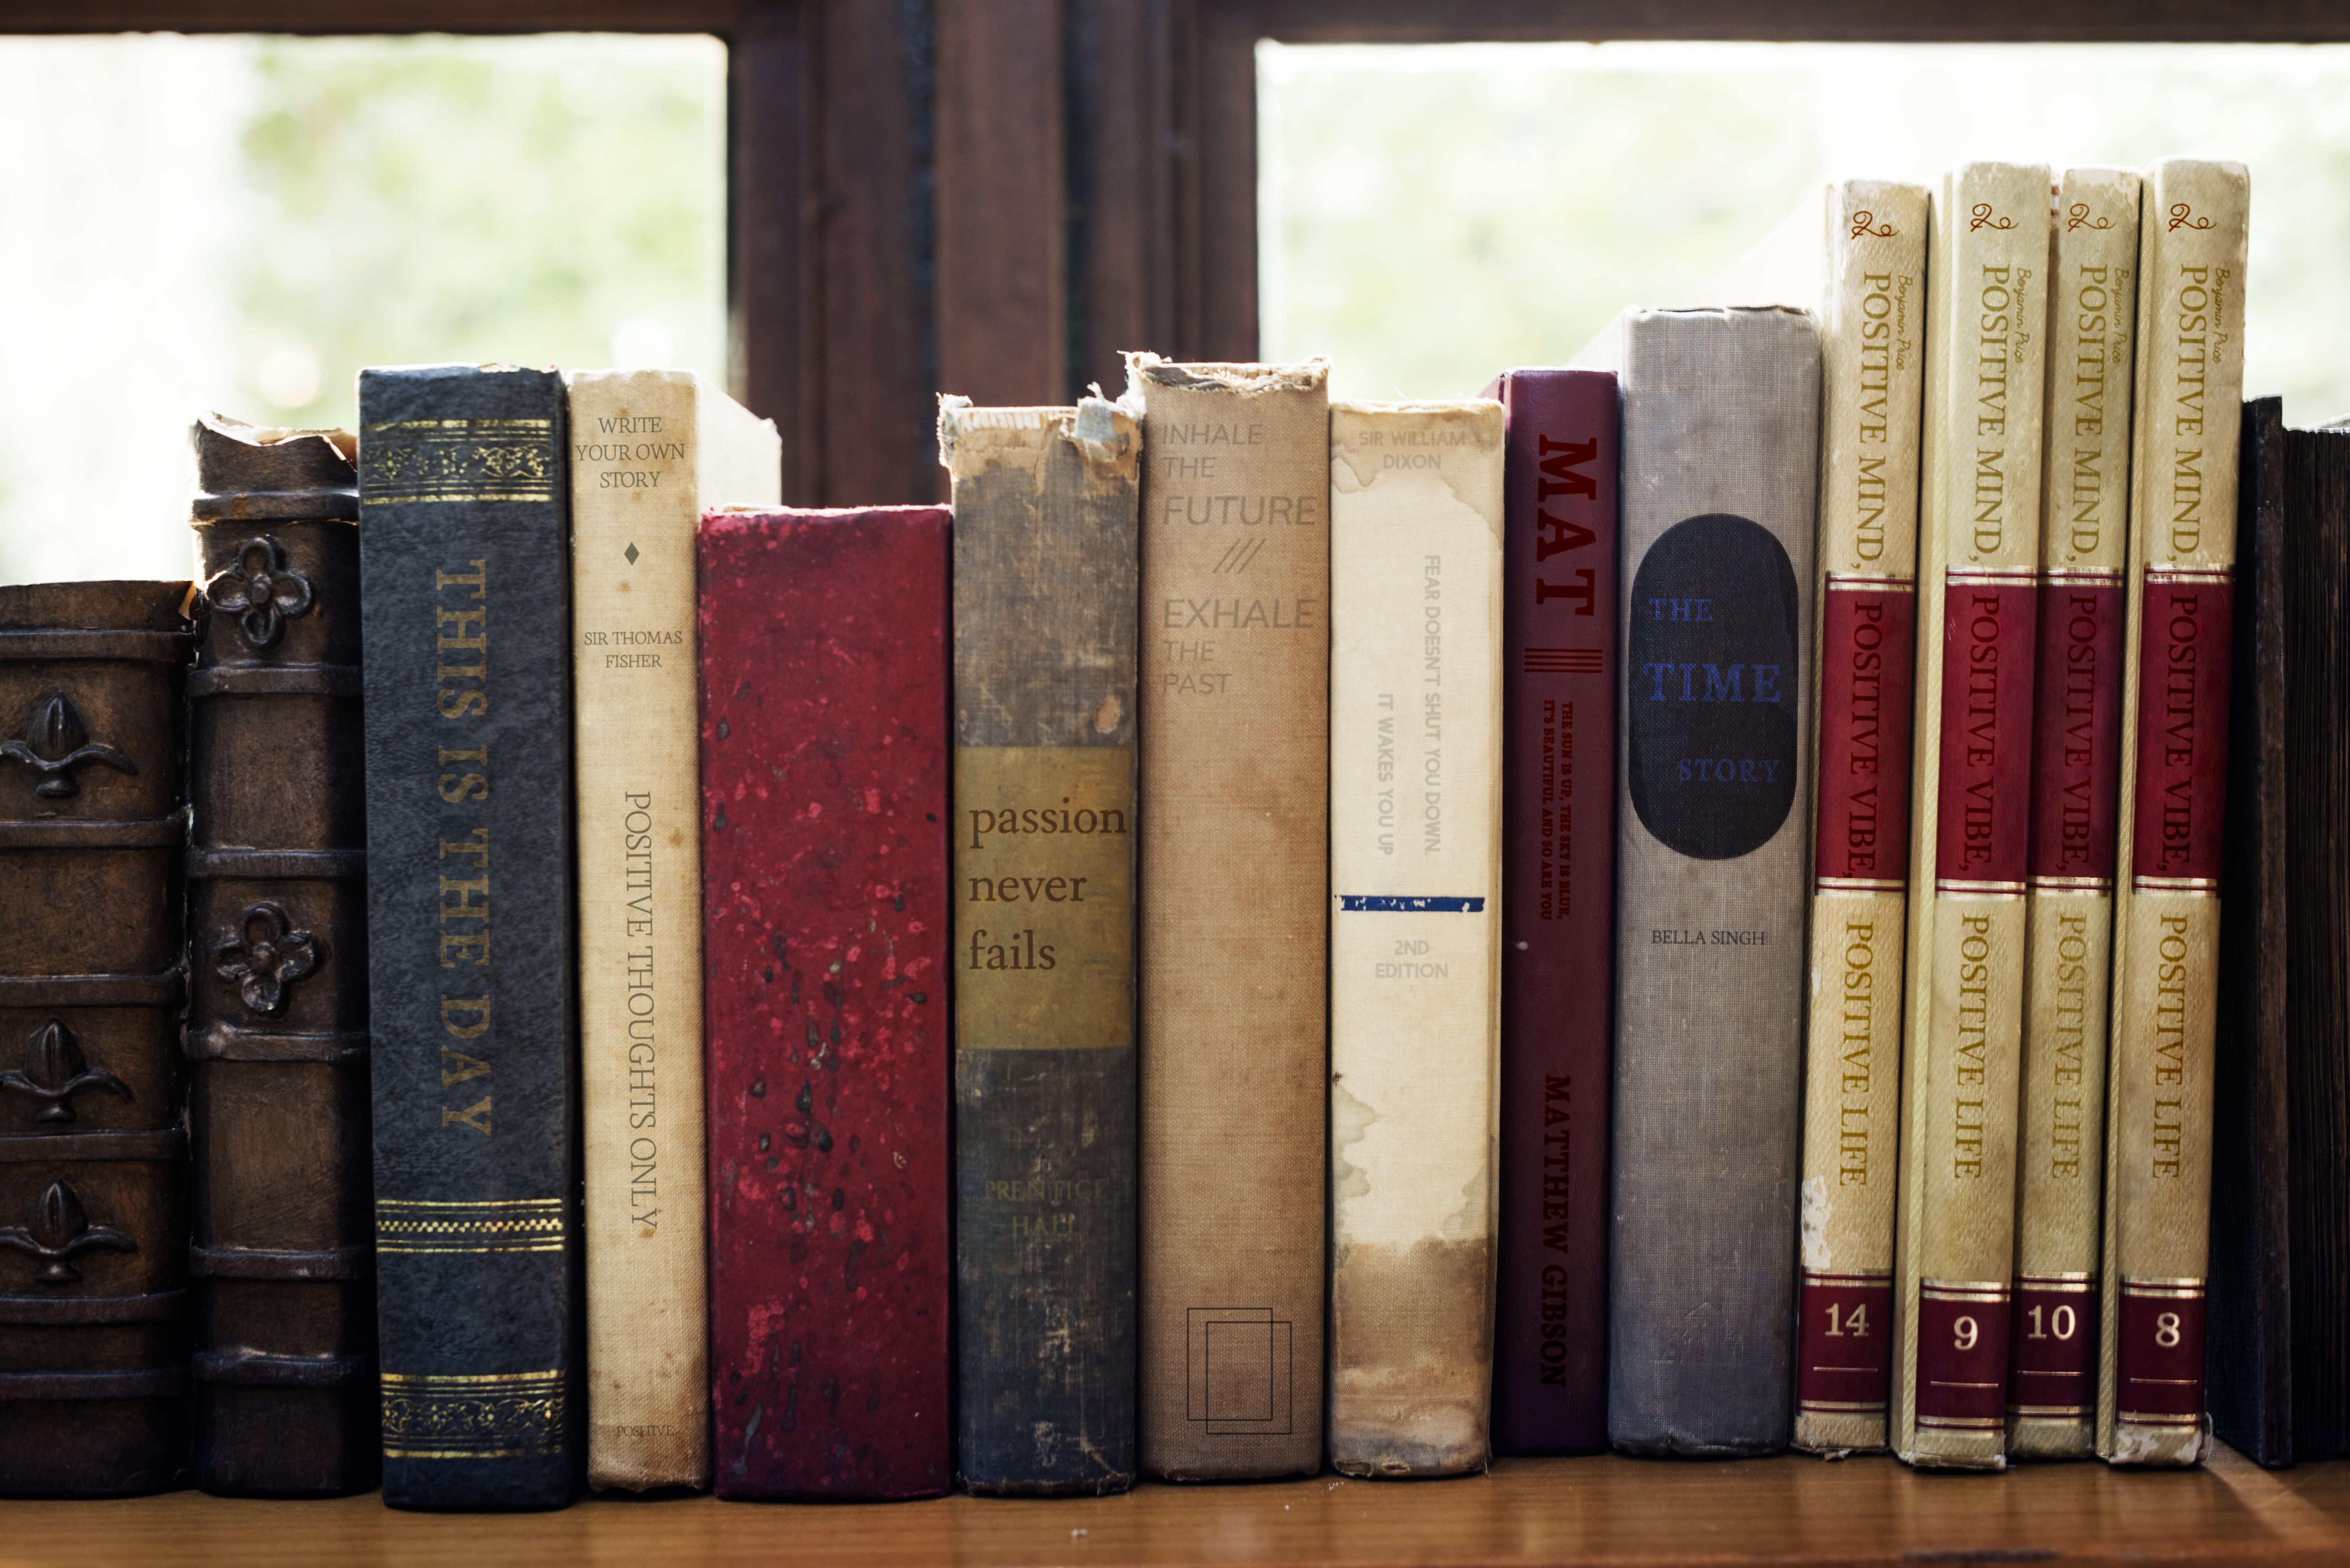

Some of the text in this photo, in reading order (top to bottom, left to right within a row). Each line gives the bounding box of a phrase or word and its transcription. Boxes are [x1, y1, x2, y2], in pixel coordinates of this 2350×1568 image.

[1894, 275, 1913, 371] Benjamin Price
[2013, 267, 2031, 364] Benjamin Price
[2110, 267, 2129, 363] Benjamin Price
[2211, 267, 2230, 363] Benjamin Price
[598, 417, 662, 434] WRITE
[1851, 271, 1891, 569] POSITIVE MIND,
[1969, 264, 2010, 562] POSITIVE MIND,
[2066, 264, 2107, 562] POSITIVE MIND,
[2166, 264, 2208, 562] POSITIVE MIND,
[576, 443, 685, 461] YOUR OWN
[1162, 424, 1262, 445] INHALE
[1359, 431, 1466, 447] SIR WILLIAM
[600, 471, 661, 488] STORY
[1162, 457, 1215, 477] THE
[1383, 454, 1441, 469] DIXON
[1163, 496, 1316, 526] FUTURE
[1536, 434, 1597, 616] MAT
[1425, 555, 1441, 600] FEAR
[1163, 598, 1316, 629] EXHALE
[1649, 598, 1712, 621] THE
[584, 631, 682, 645] SIR THOMAS
[1163, 640, 1215, 661] THE
[605, 655, 662, 668] FISHER
[1162, 673, 1232, 694] PAST
[1643, 663, 1781, 702] TIME
[1425, 693, 1441, 741] SHUT
[1958, 594, 1999, 872] POSITIVE VIBE,
[2055, 594, 2097, 872] POSITIVE VIBE,
[2156, 594, 2198, 872] POSITIVE VIBE,
[1842, 602, 1882, 878] POSITIVE VIBE,
[1378, 694, 1394, 855] IT WAKES YOU UP
[1425, 748, 1441, 786] YOU
[1678, 759, 1780, 782] STORY
[969, 797, 1127, 849] passion
[1540, 700, 1555, 920] IT'S BEAUTIFUL AND SO ARE YOU
[1556, 701, 1573, 919] THE SUN IS UP, THE SKY IS BLUE,
[437, 559, 491, 1136] THIS IS THE DAY
[969, 877, 1087, 901] never
[969, 929, 1056, 970] fails
[1394, 940, 1430, 955] 2ND
[1651, 930, 1765, 945] BELLA SINGH
[1376, 963, 1448, 978] EDITION
[625, 791, 658, 1229] POSITIVE THOUGHTS ONLY
[1839, 921, 1873, 1186] POSITIVE LIFE
[1954, 913, 1990, 1179] POSITIVE LIFE
[2052, 913, 2087, 1179] POSITIVE LIFE
[2152, 913, 2188, 1179] POSITIVE LIFE
[1540, 1073, 1571, 1387] MATTHEW GIBSON
[1825, 1303, 1869, 1337] 14
[1954, 1316, 1978, 1350] 9
[2028, 1305, 2076, 1340] 10
[2156, 1312, 2180, 1348] 8
[616, 1425, 675, 1436] POSITIVE
